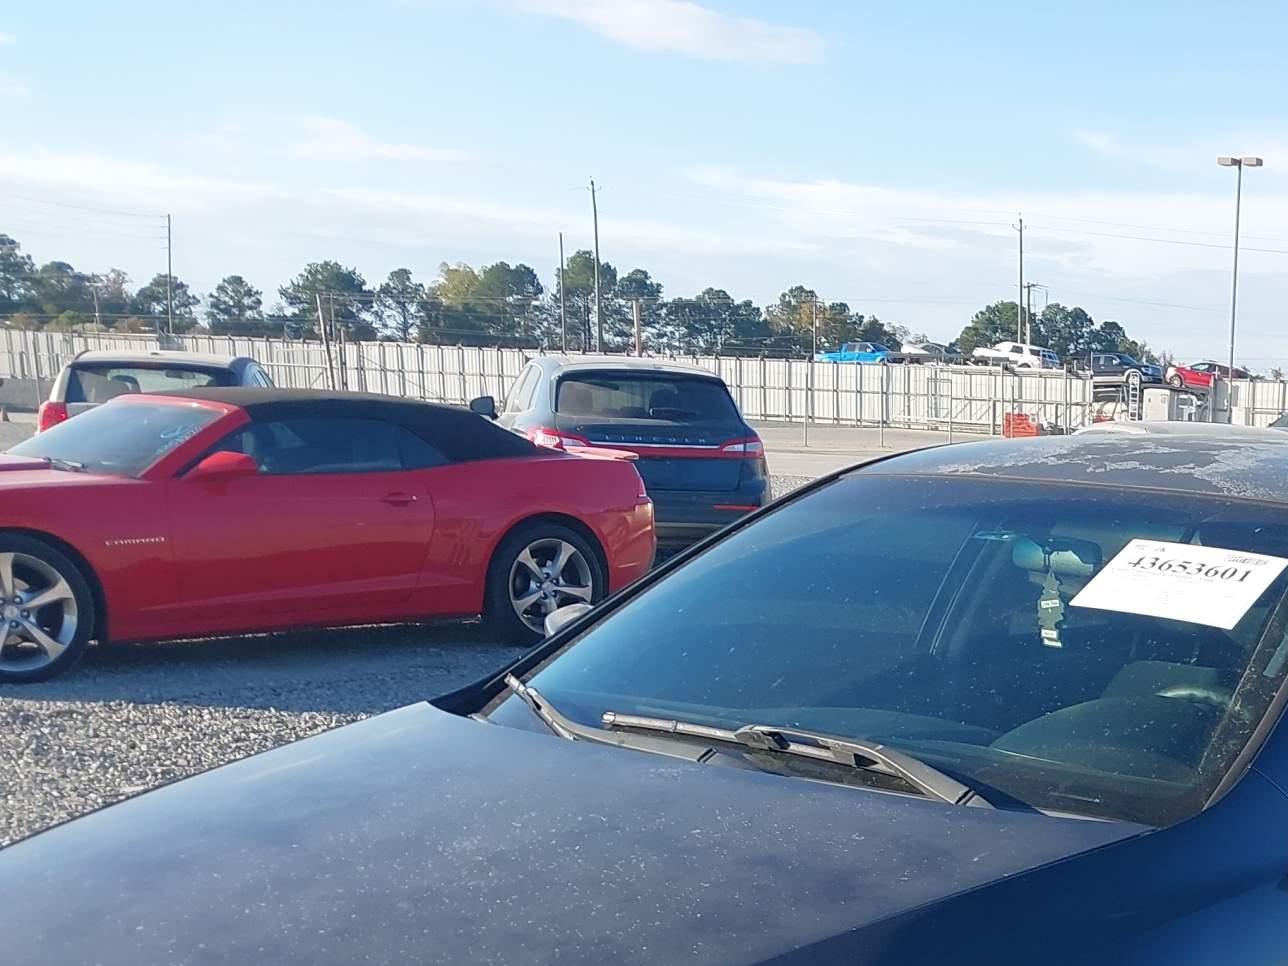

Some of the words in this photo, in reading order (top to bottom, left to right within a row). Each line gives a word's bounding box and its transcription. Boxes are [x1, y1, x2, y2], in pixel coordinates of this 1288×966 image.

[604, 434, 706, 443] LINCOLN
[104, 536, 166, 546] CAMARO
[1127, 556, 1253, 583] 43653601
